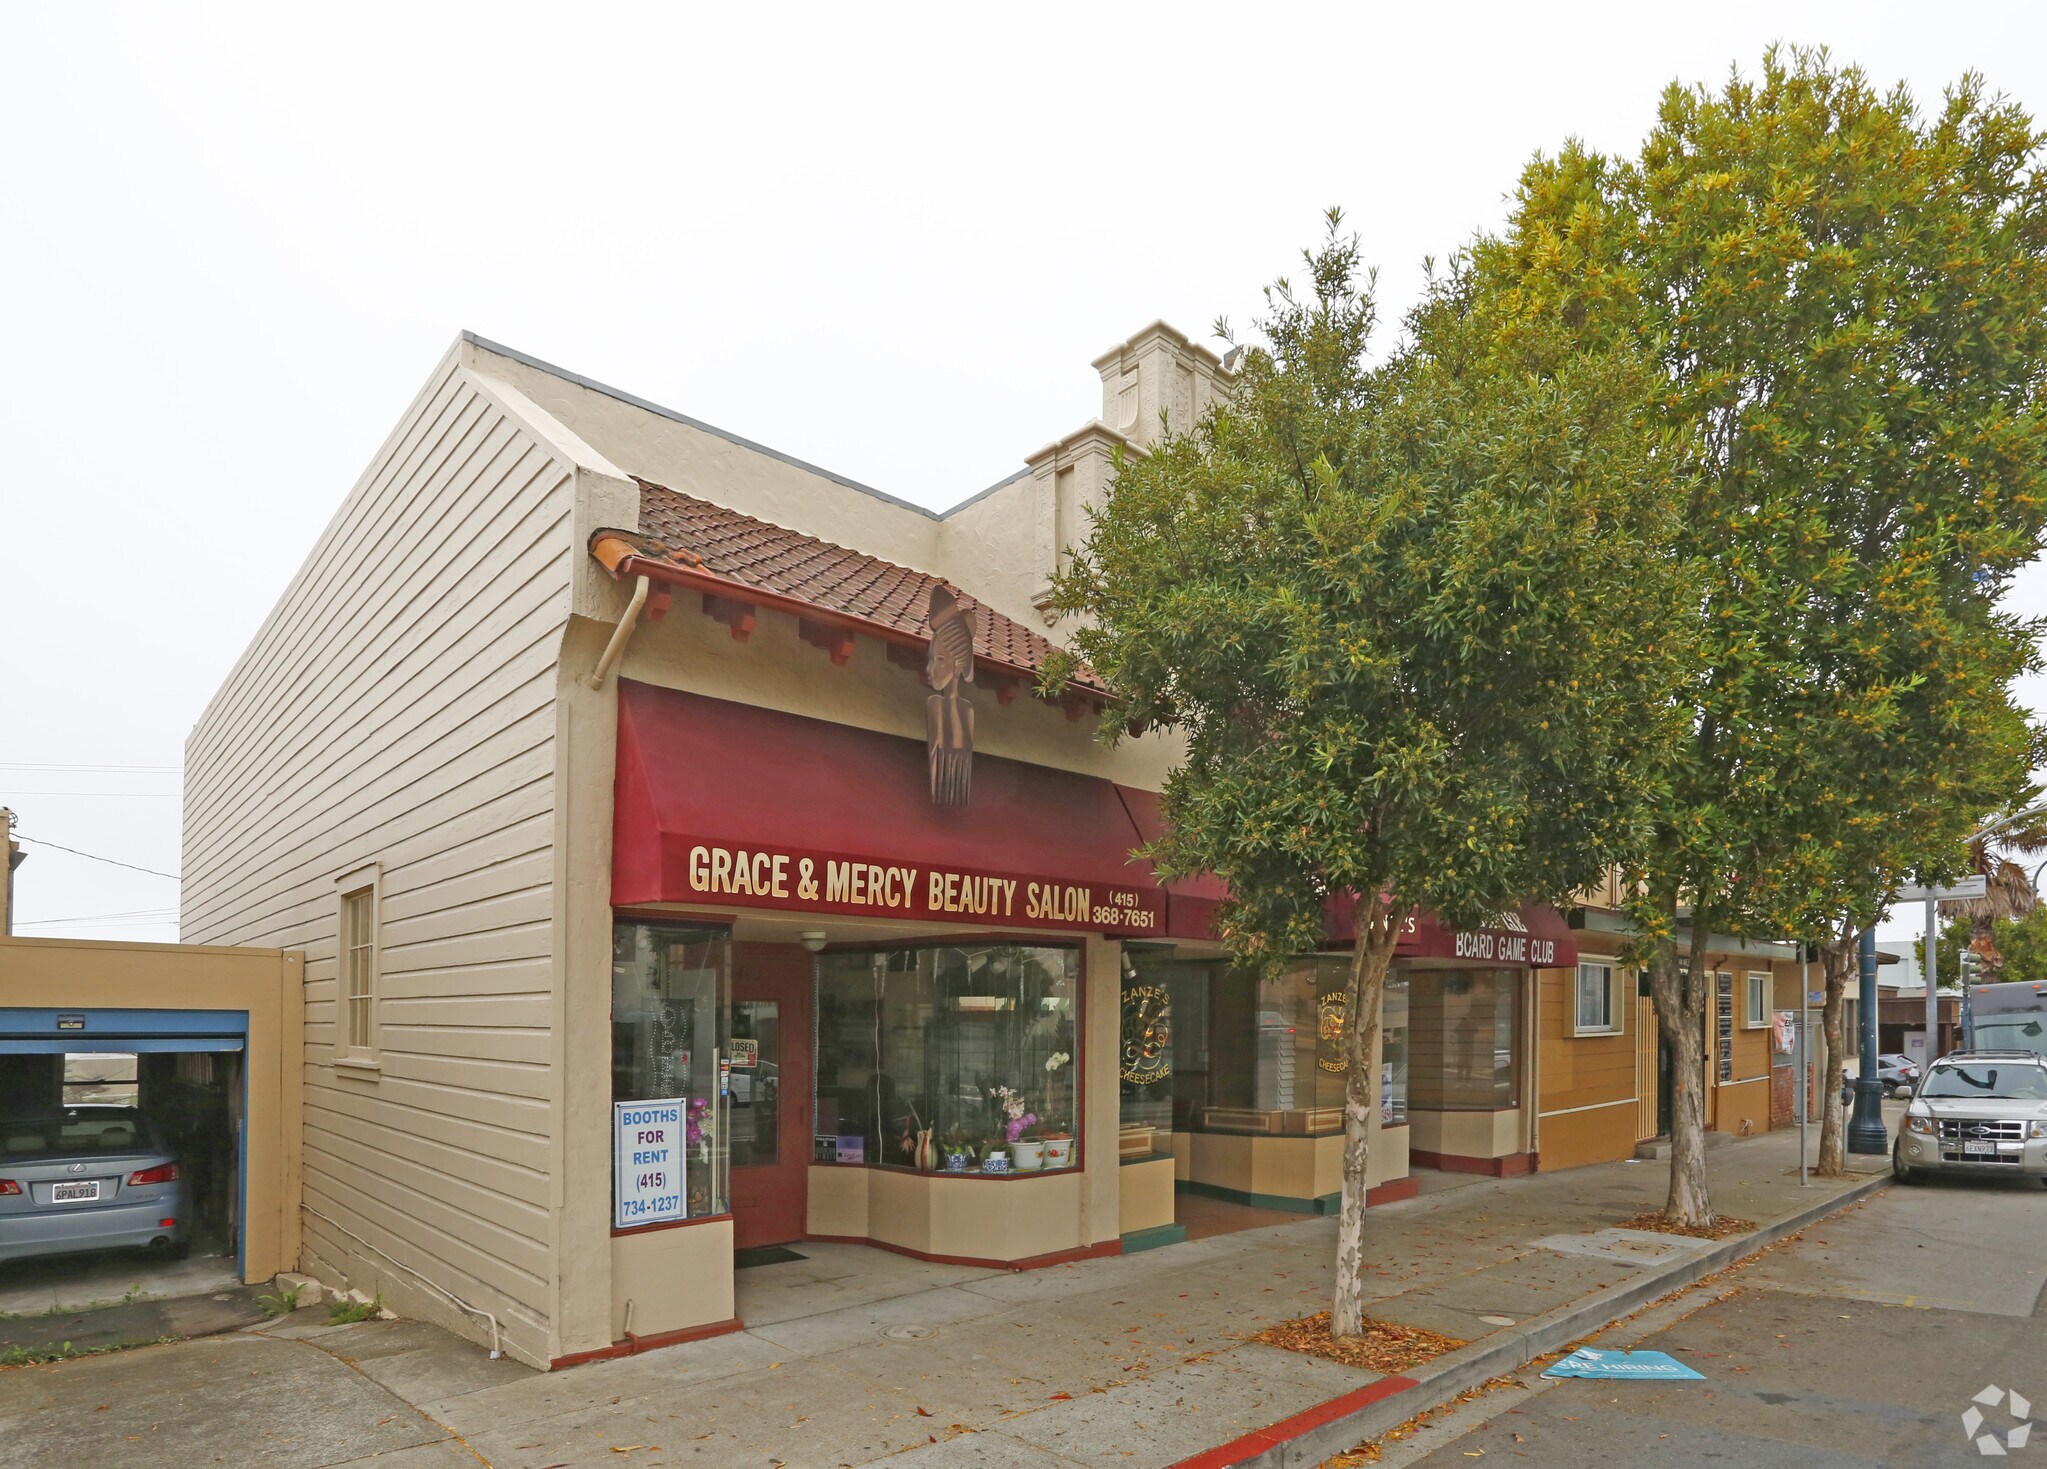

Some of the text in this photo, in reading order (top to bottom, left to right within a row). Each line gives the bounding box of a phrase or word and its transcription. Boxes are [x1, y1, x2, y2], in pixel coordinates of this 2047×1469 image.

[689, 846, 1090, 922] GRACE & MERCY BEAUTY SALON
[1109, 890, 1139, 908] (415)
[1456, 931, 1554, 963] BOARD GAME CLUB
[1121, 986, 1170, 1005] ZANZE'S
[1321, 992, 1347, 1007] ZANZE
[731, 1042, 755, 1053] LOSED
[1119, 1063, 1170, 1085] CHEESECAKE
[623, 1109, 678, 1125] BOOTHS
[638, 1130, 664, 1144] FOR
[633, 1149, 669, 1165] RENT
[636, 1171, 666, 1193] (415)
[55, 1188, 97, 1200] 6PAL918
[623, 1195, 679, 1216] 734-1237
[1601, 1363, 1679, 1372] HIRING
